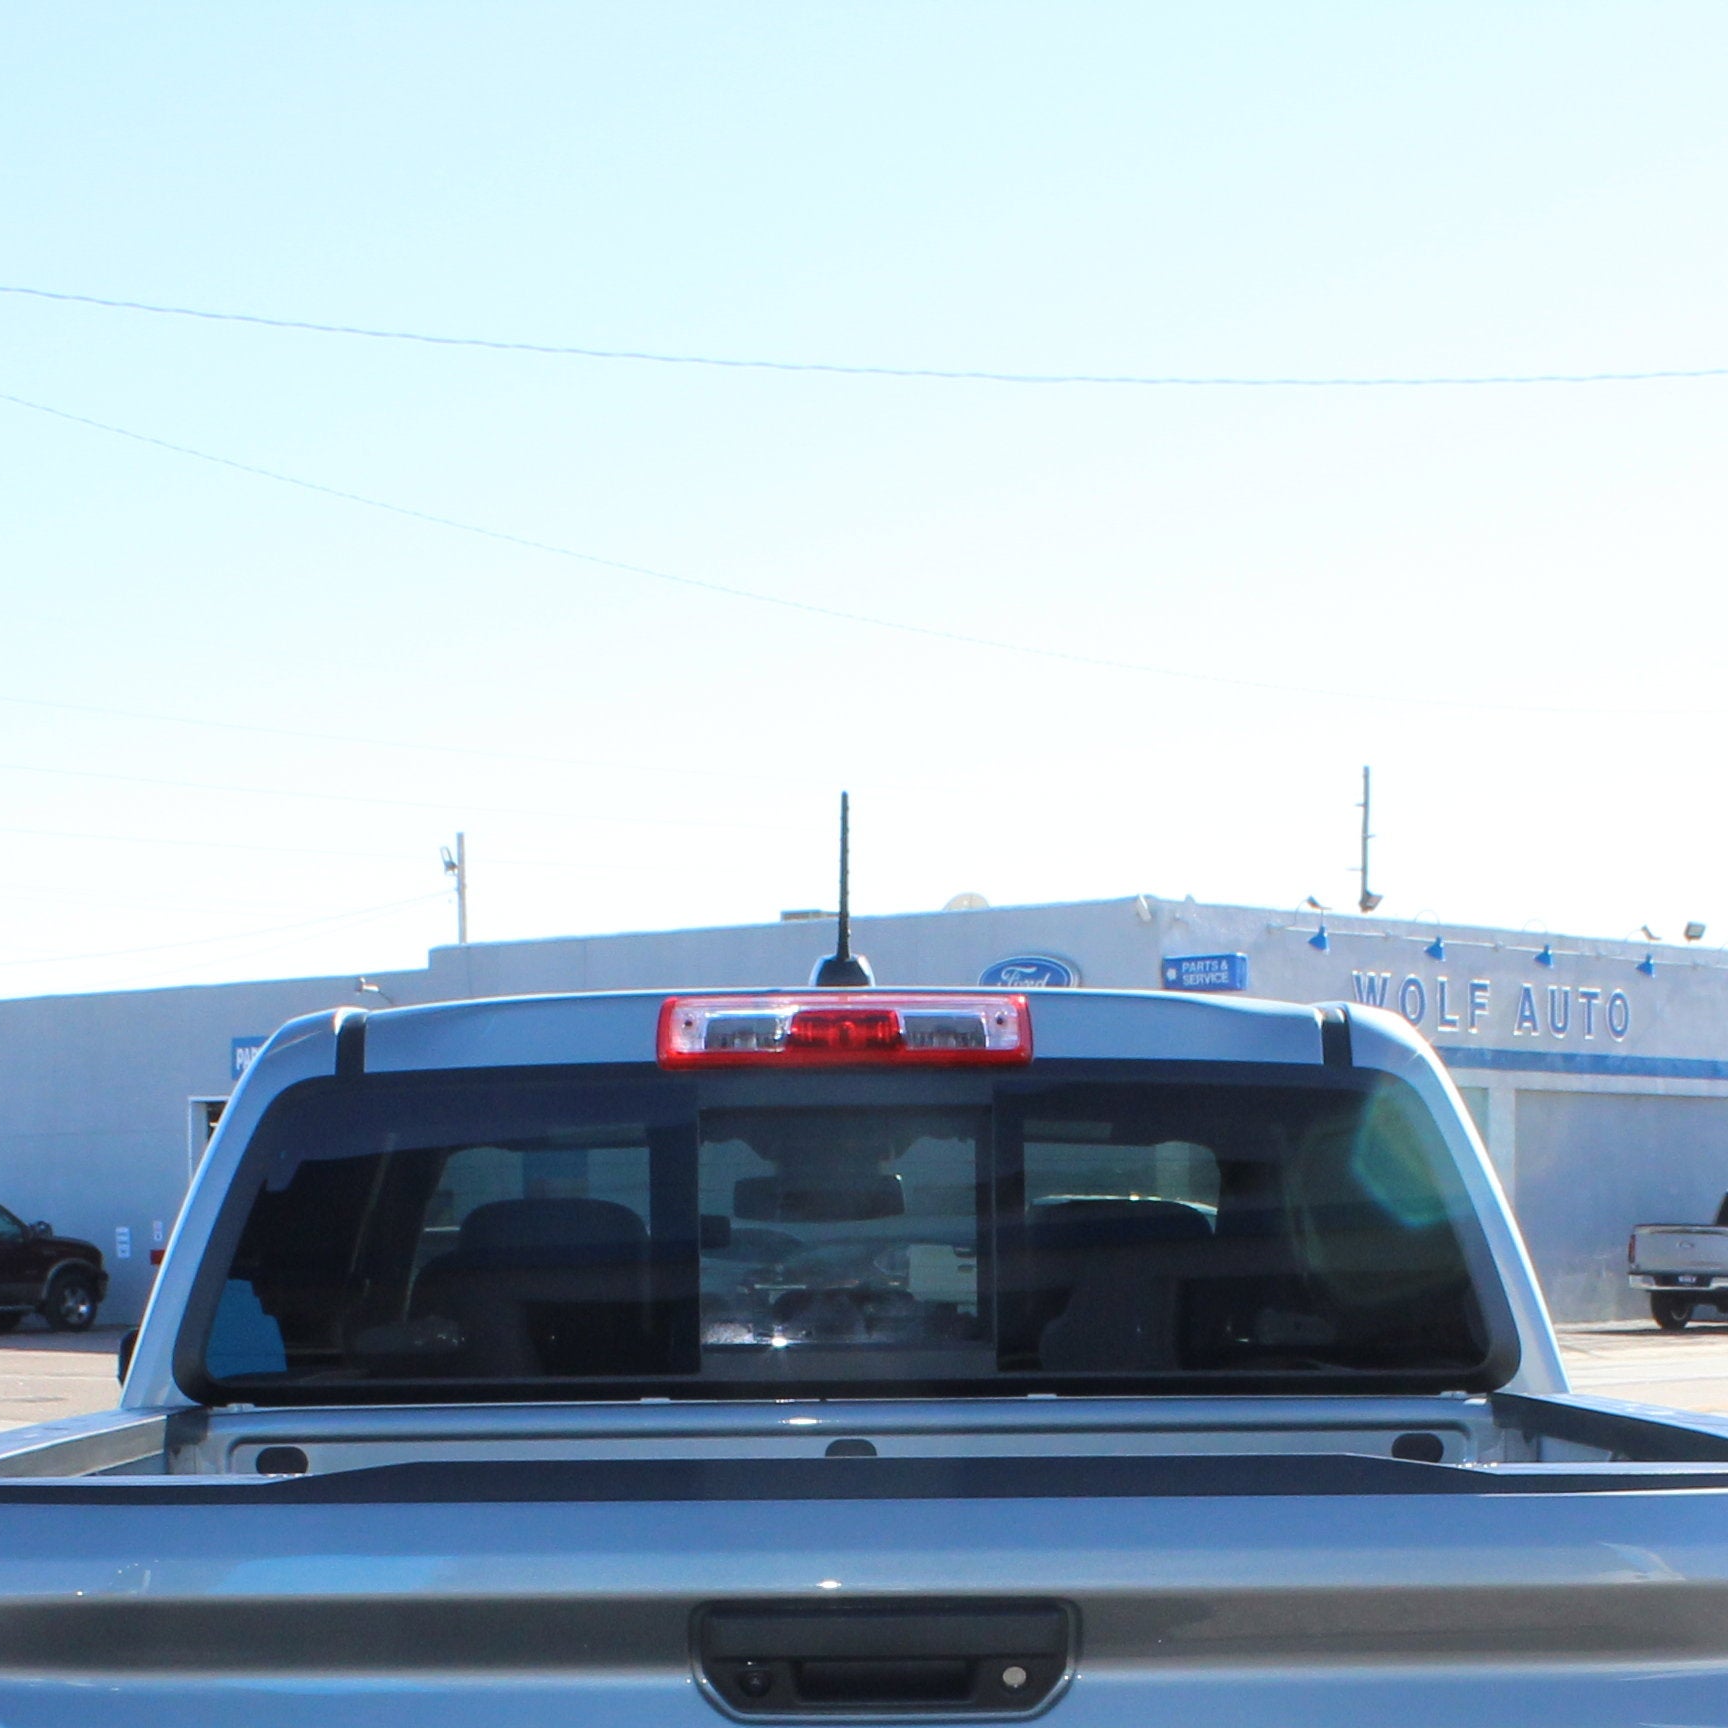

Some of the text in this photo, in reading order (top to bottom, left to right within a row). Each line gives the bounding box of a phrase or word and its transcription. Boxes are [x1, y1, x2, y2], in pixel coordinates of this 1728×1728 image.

[1182, 960, 1228, 972] PARTS &
[1182, 971, 1230, 985] SERVICE
[1352, 971, 1631, 1042] WOLF AUTO
